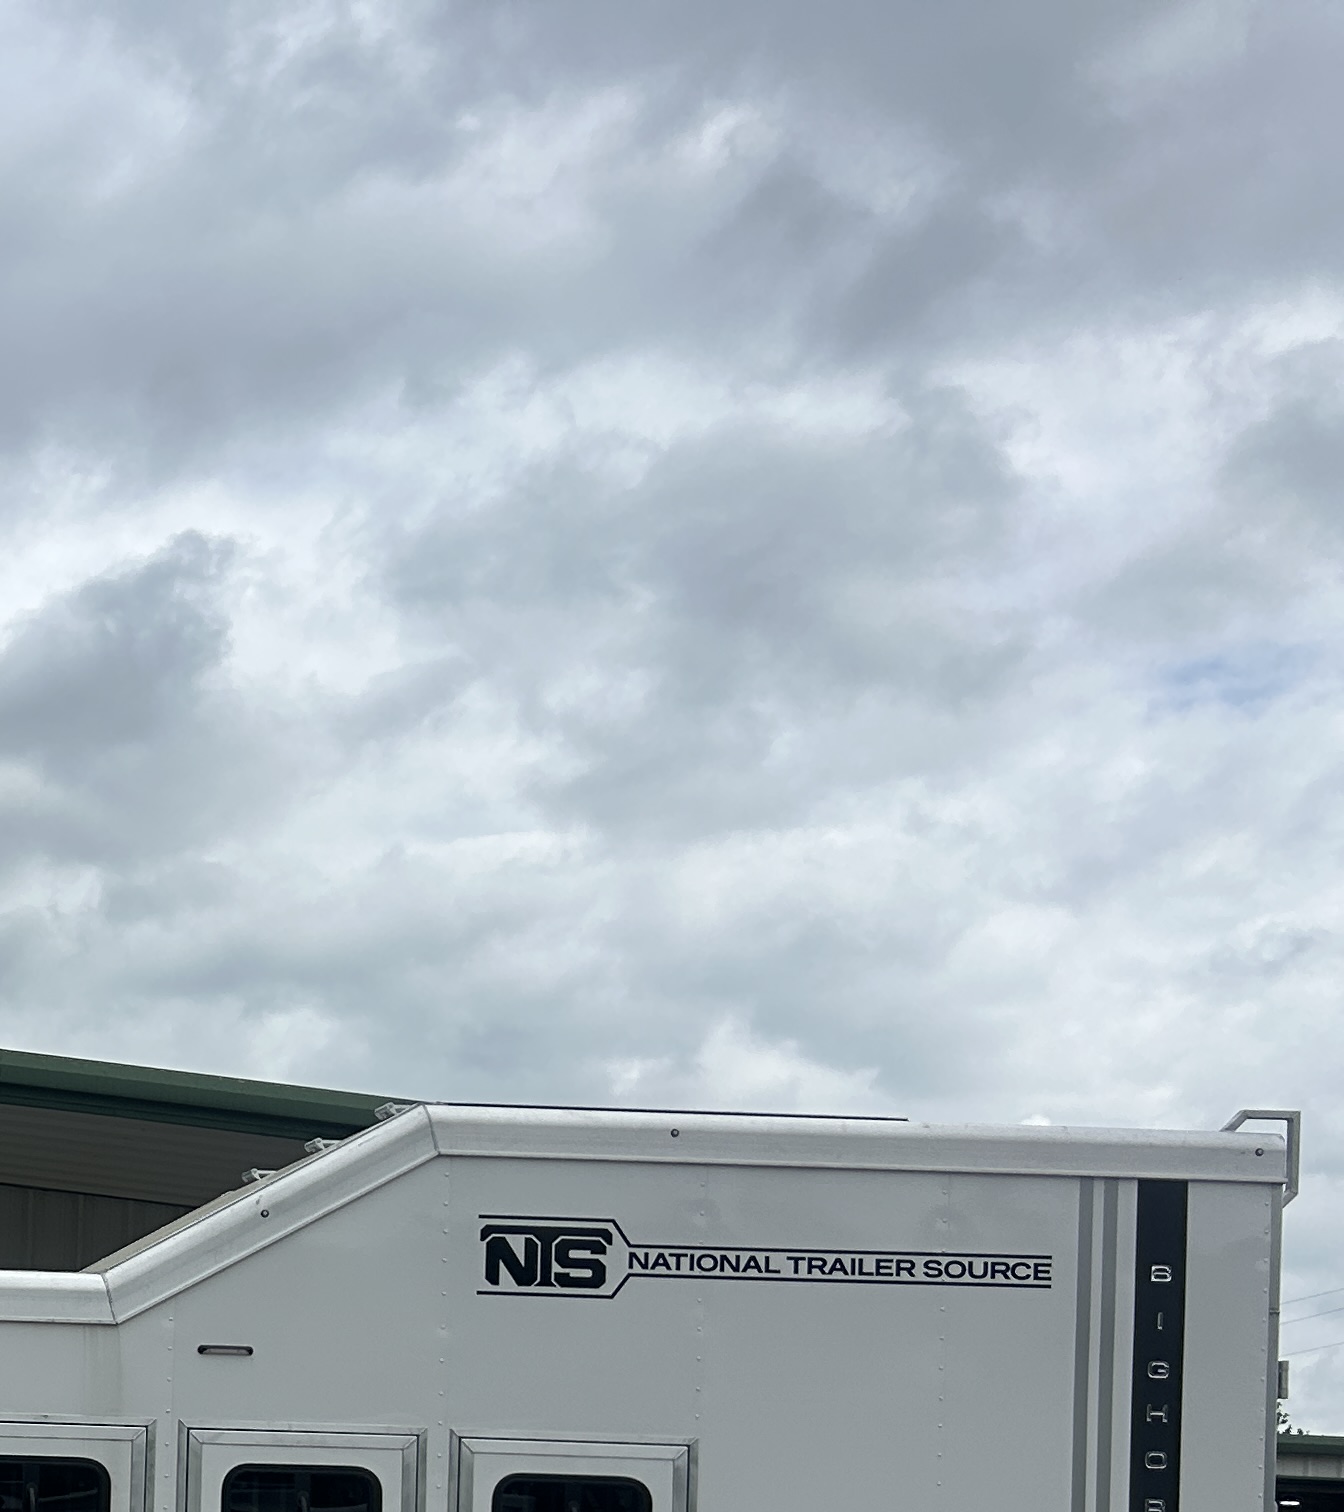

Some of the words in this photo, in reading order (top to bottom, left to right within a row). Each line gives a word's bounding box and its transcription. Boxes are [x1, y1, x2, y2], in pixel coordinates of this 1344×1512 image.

[480, 1224, 613, 1289] NTS
[627, 1251, 781, 1274] NATIONAL
[786, 1255, 916, 1278] TRAILER
[922, 1259, 1053, 1282] SOURCE
